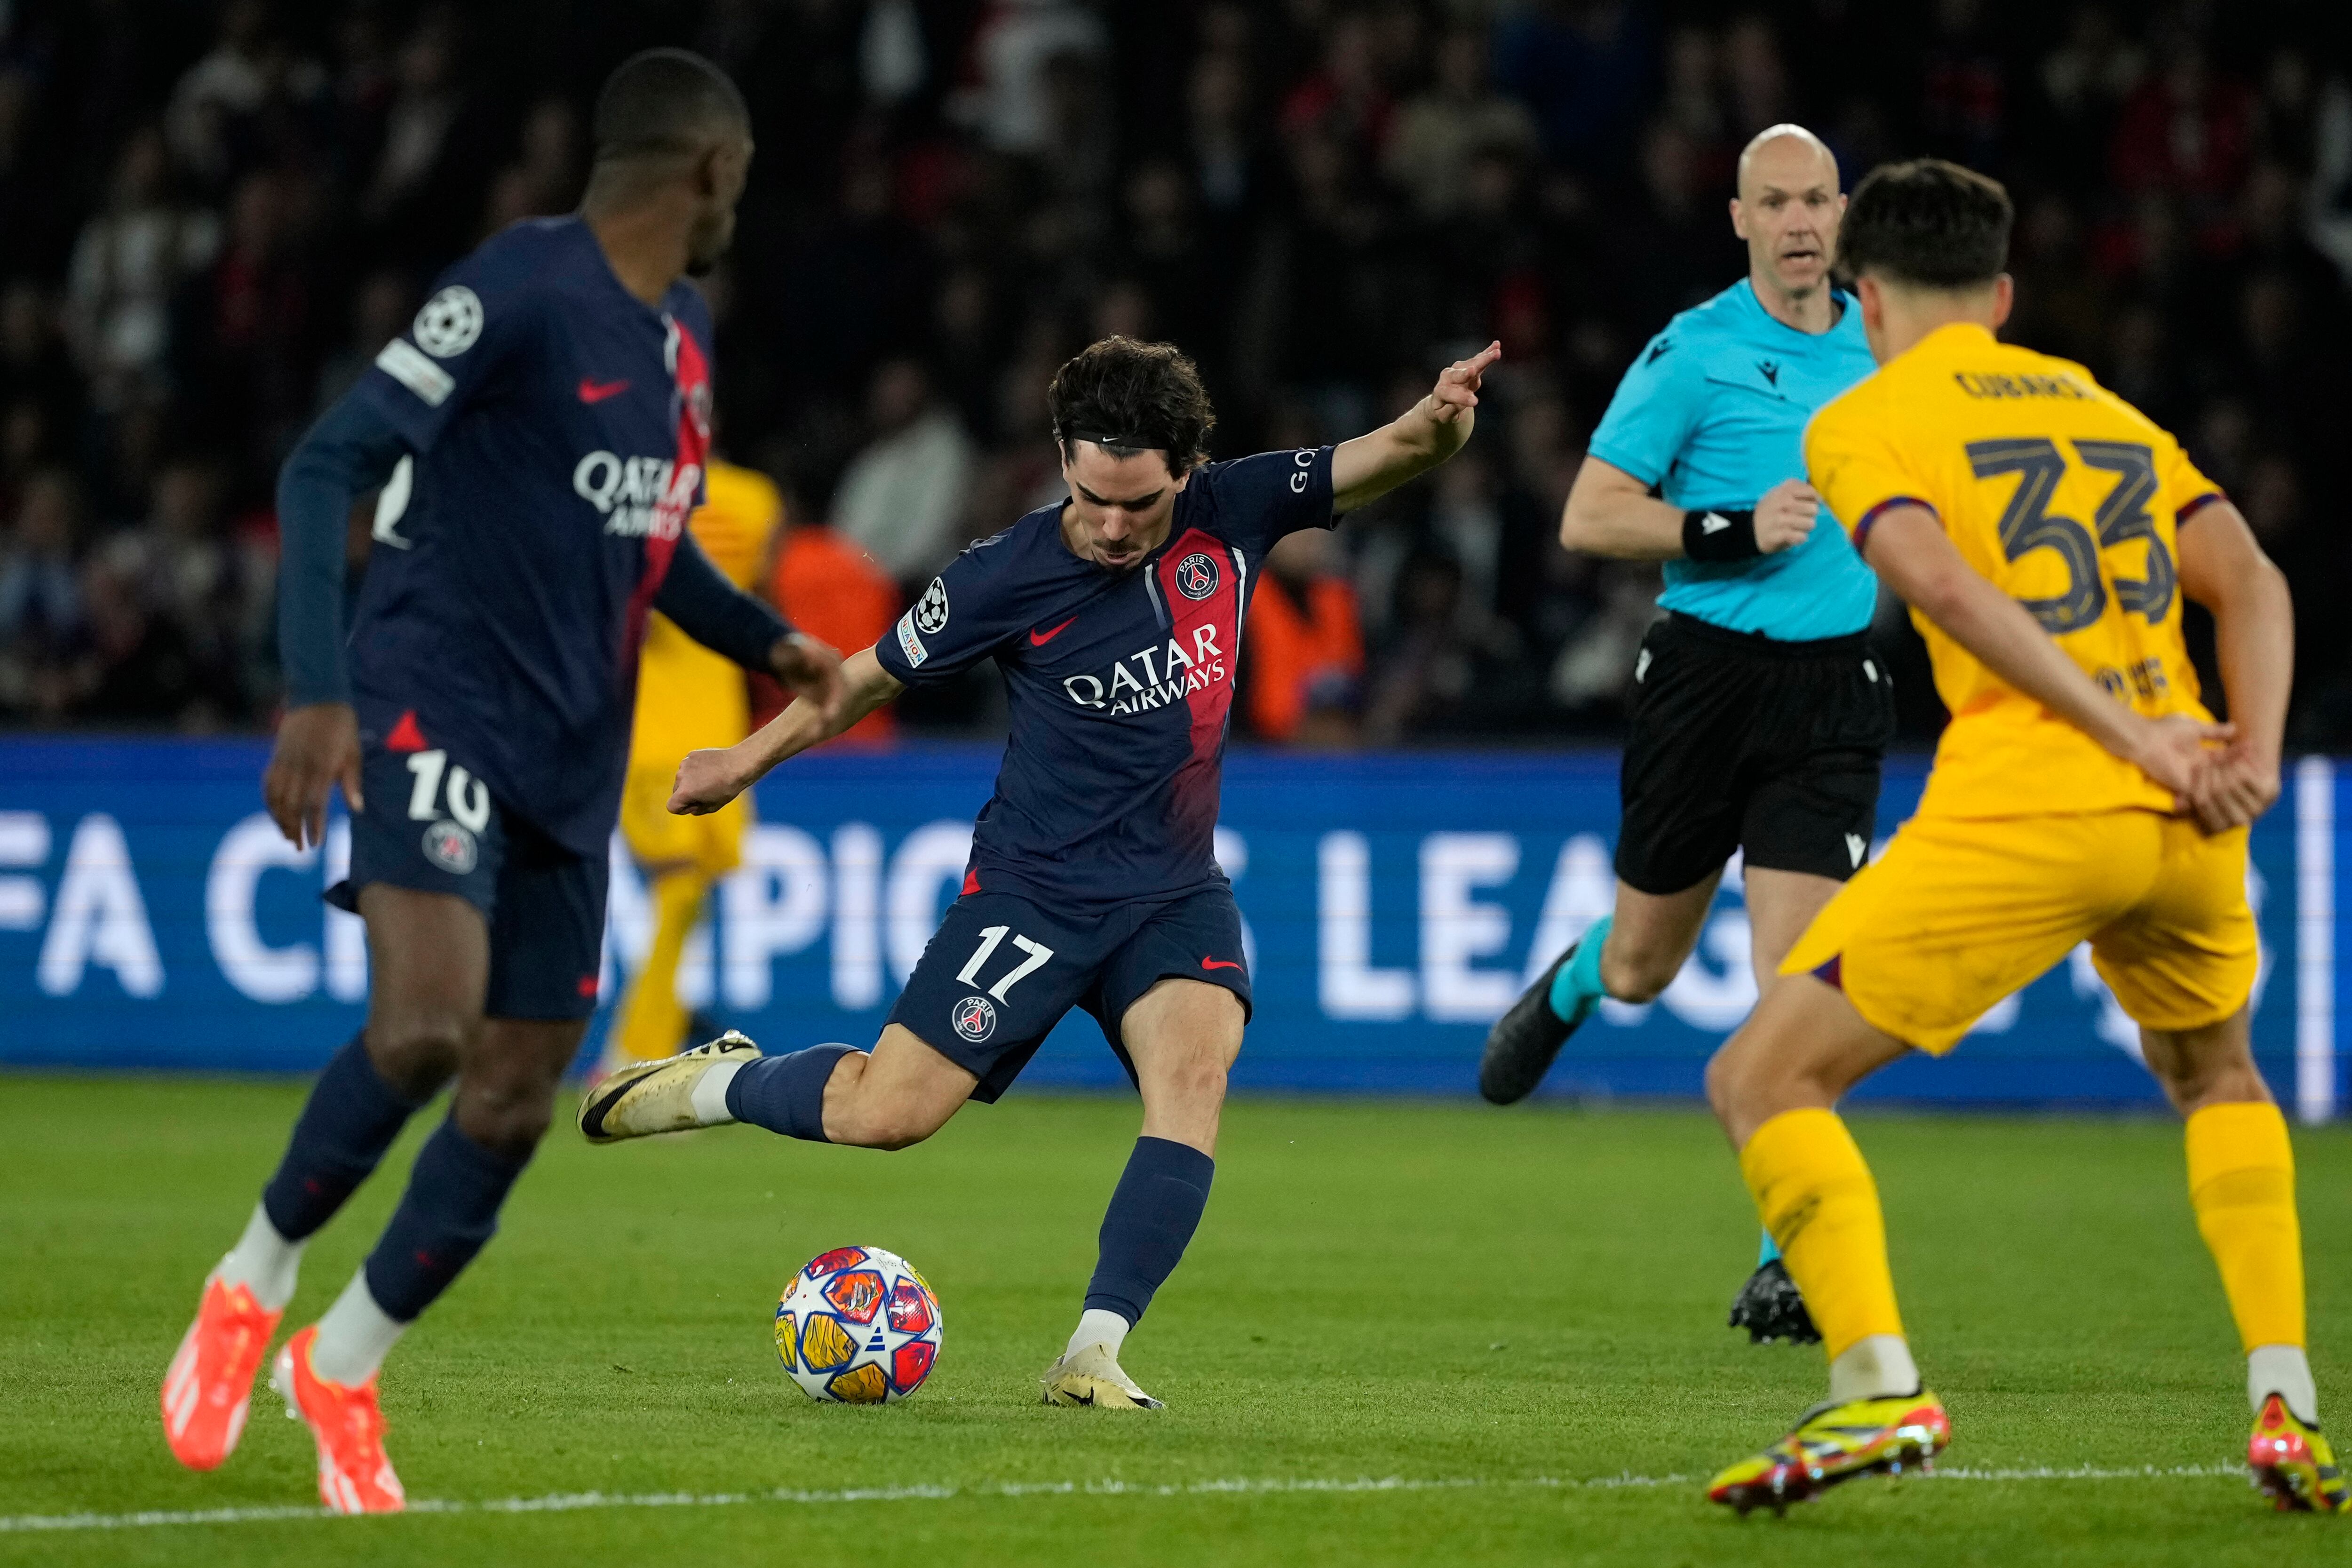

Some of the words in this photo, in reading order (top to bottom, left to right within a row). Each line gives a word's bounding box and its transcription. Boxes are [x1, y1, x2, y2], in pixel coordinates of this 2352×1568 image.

[1290, 448, 1319, 493] GO
[1179, 556, 1205, 573] PARIS
[1964, 438, 2177, 635] 33
[902, 615, 923, 662] NDATION
[1063, 623, 1223, 708] QATAR
[1110, 658, 1225, 716] AIRWAYS
[406, 748, 490, 833] 10
[955, 925, 1055, 1008] 17
[967, 999, 993, 1018] PARIS
